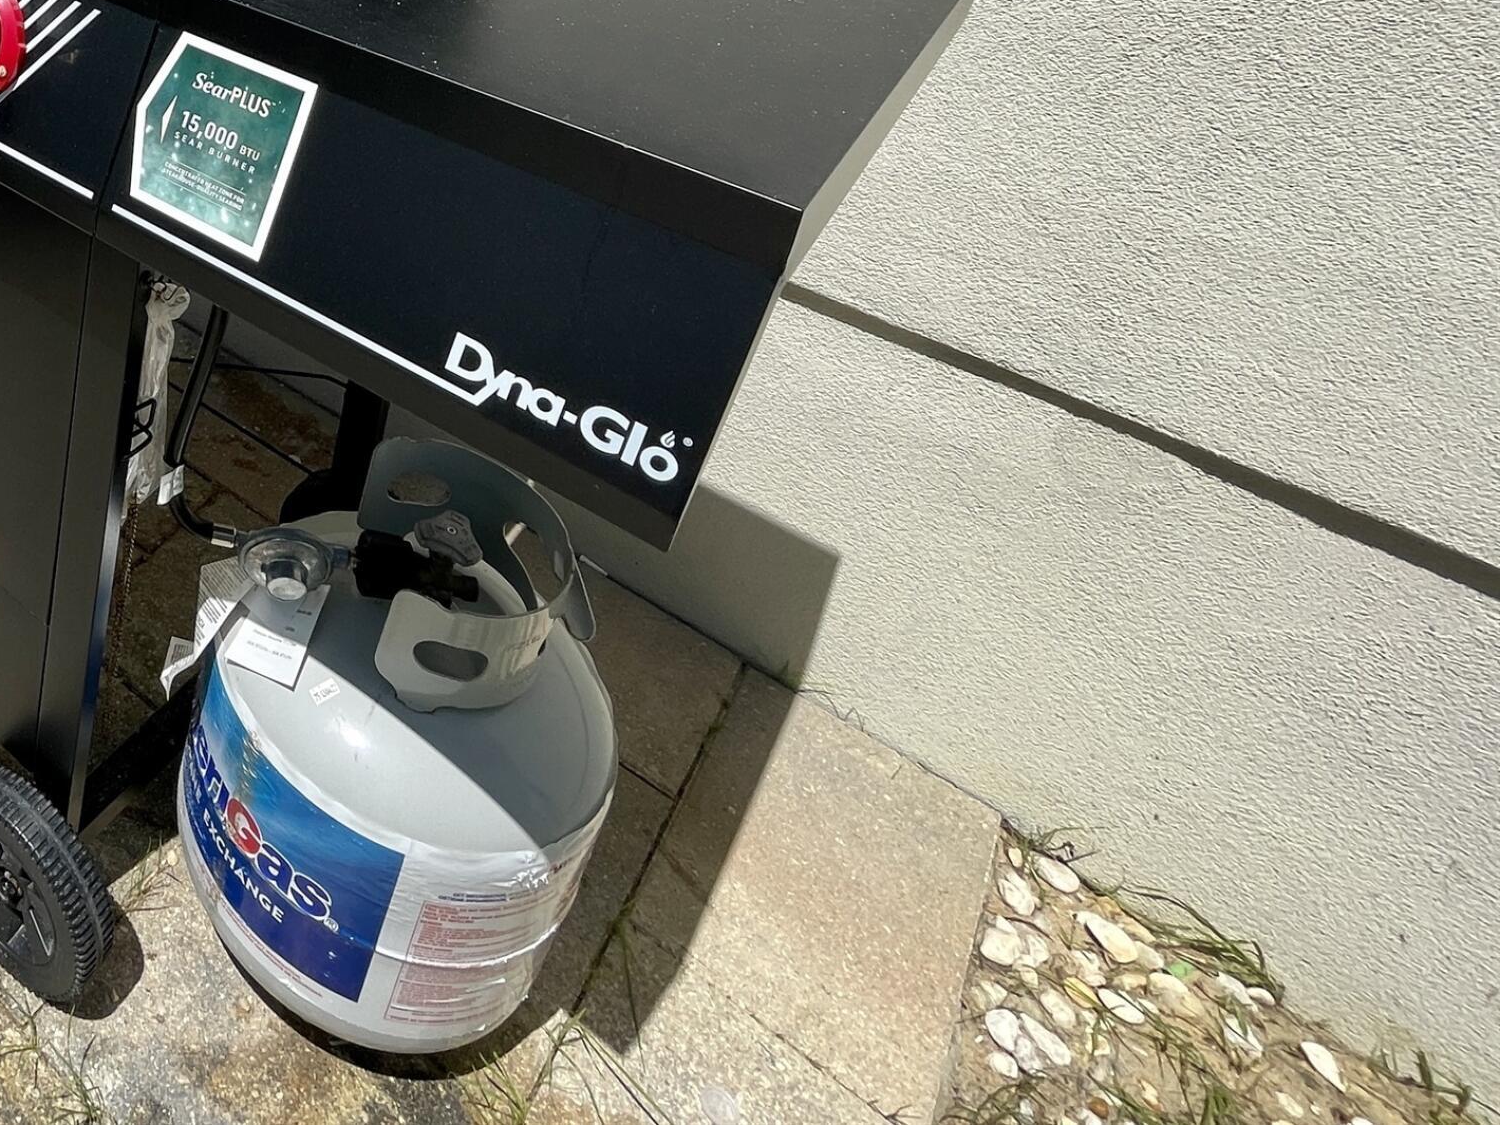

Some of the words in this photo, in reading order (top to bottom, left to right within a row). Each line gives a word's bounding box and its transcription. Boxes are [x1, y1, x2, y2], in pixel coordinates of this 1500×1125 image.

[192, 72, 273, 118] SearPLUS
[174, 131, 203, 150] SEAR
[208, 147, 256, 175] BURNER
[180, 110, 239, 150] 15,000
[239, 145, 261, 162] BTU
[232, 194, 245, 204] FOR
[444, 331, 679, 482] Dyna-Glo
[192, 725, 332, 921] eriGas
[203, 807, 284, 923] EXCHANGE
